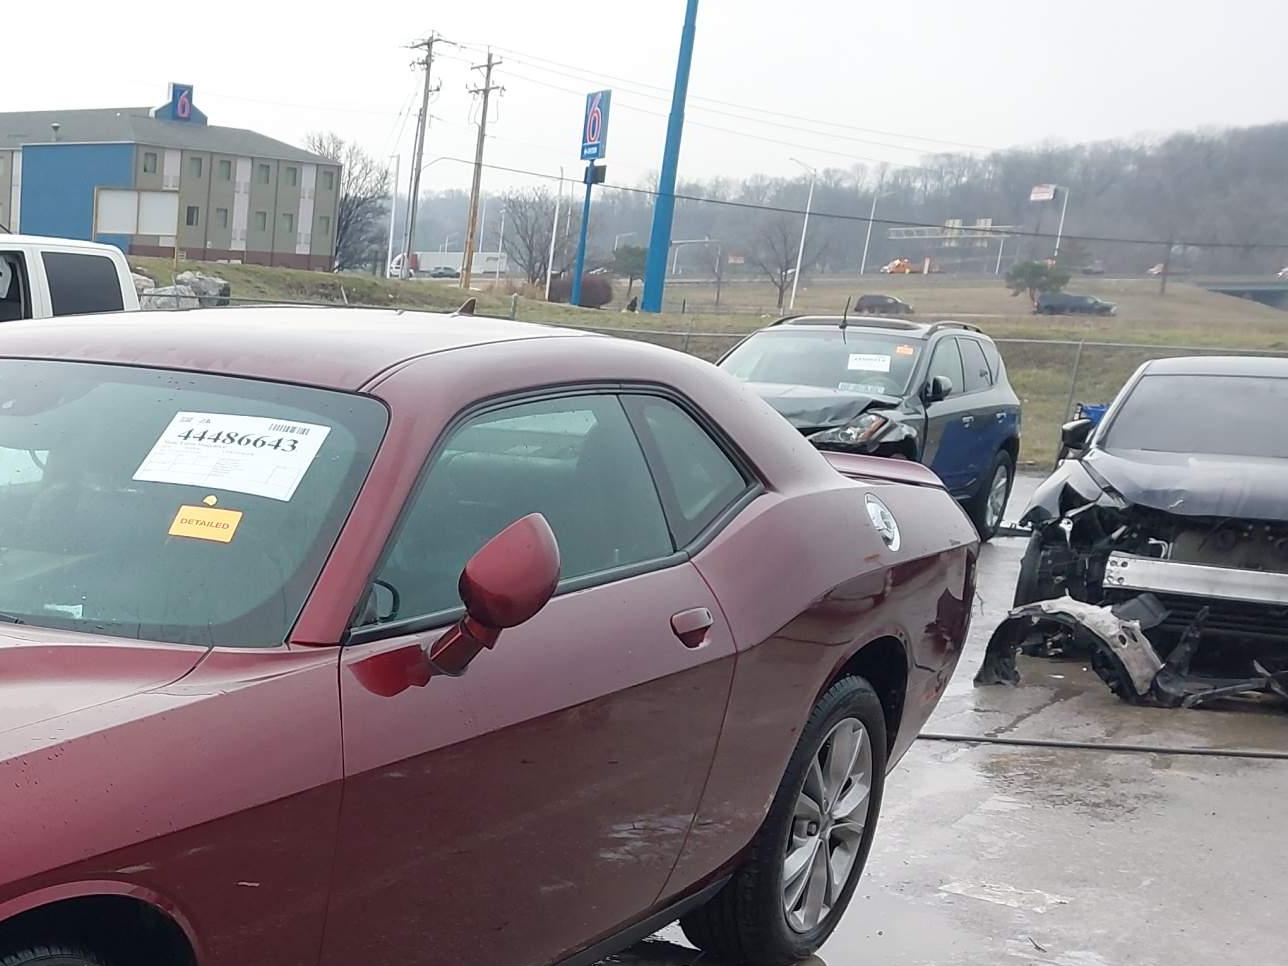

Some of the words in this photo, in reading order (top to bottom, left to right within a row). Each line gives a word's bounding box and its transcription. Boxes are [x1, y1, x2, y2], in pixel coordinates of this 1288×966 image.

[177, 90, 190, 117] 6
[586, 91, 601, 143] 6
[177, 427, 299, 453] 44486643
[180, 518, 230, 530] DETAILED
